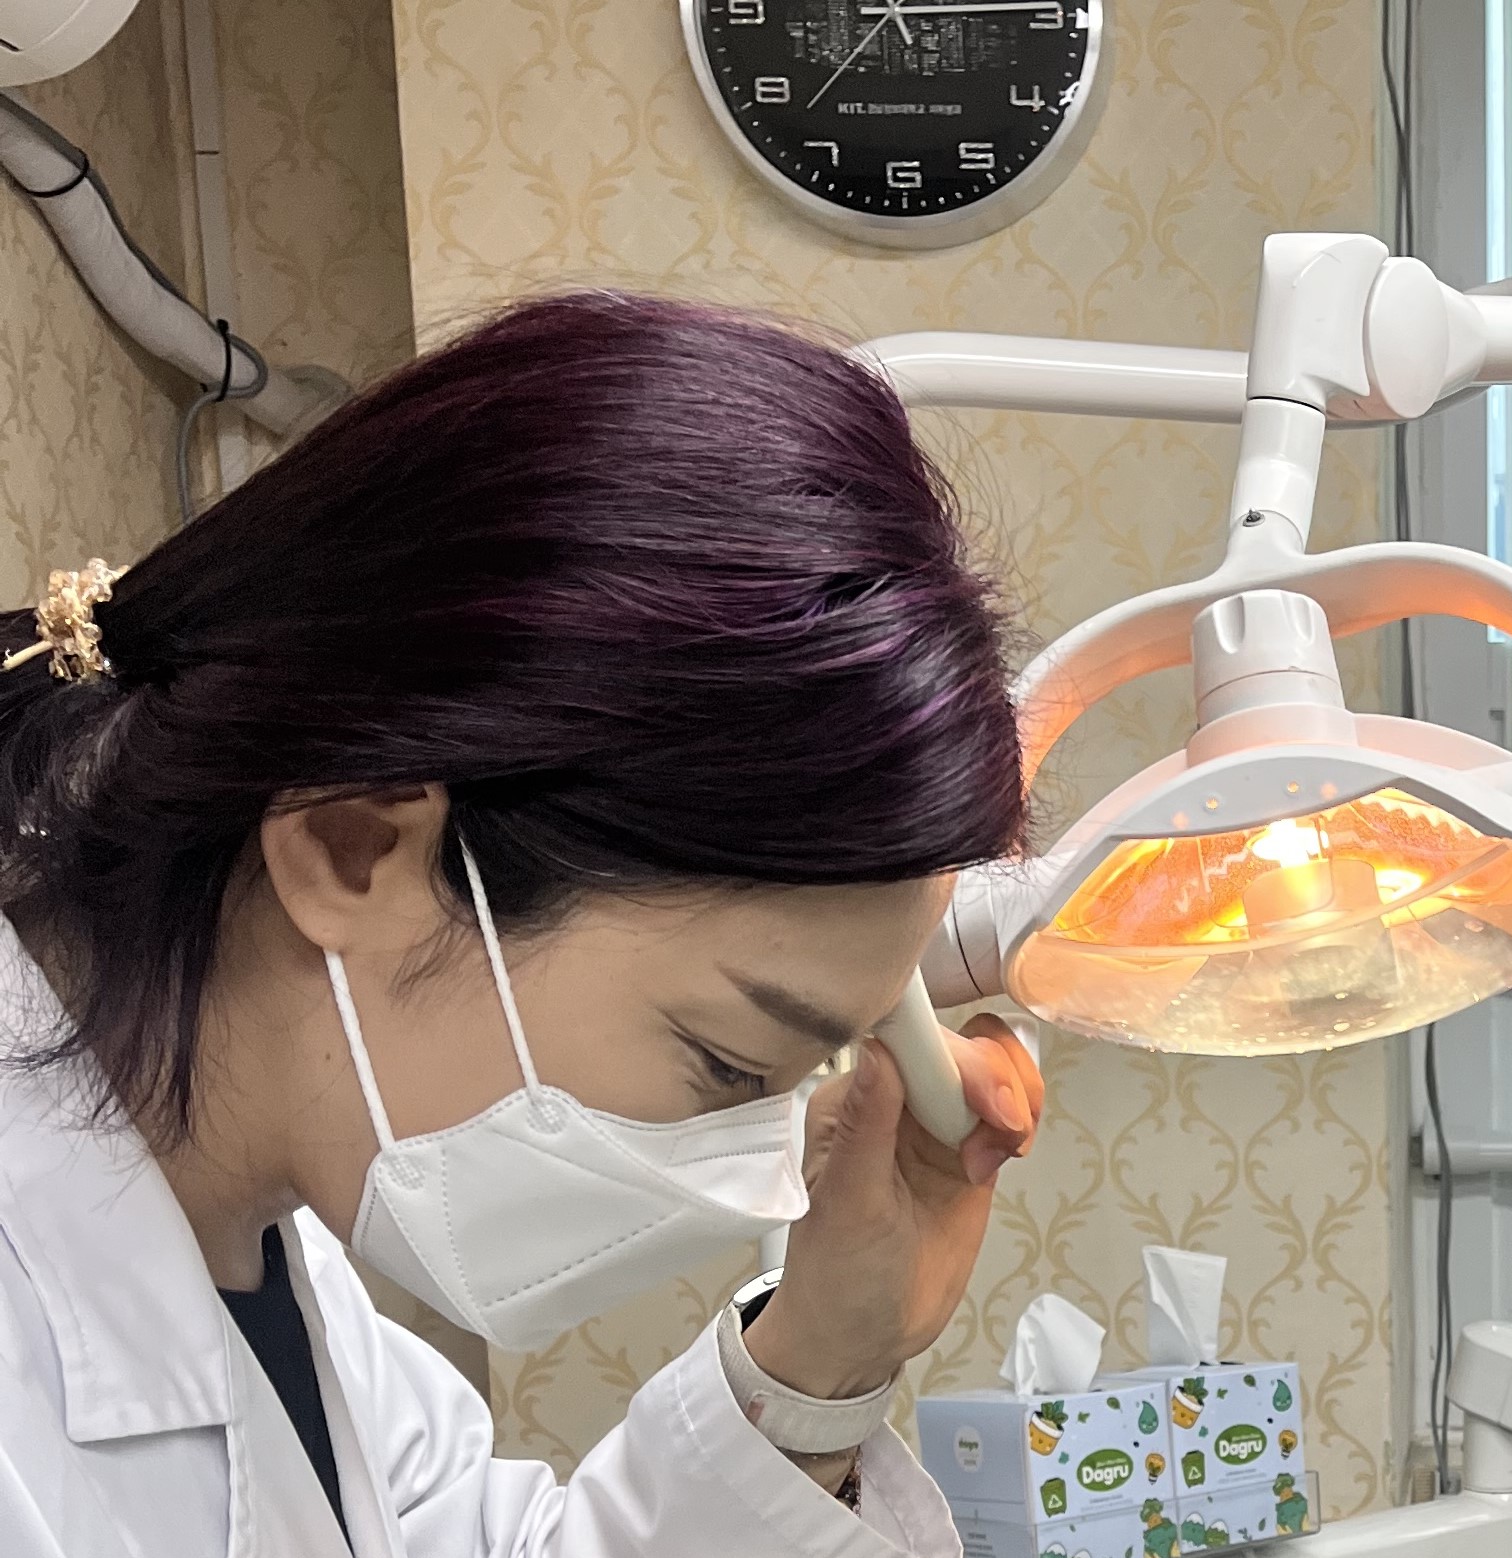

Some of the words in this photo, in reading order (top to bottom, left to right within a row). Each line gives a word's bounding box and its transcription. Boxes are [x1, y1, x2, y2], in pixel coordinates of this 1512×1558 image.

[754, 76, 790, 103] 8
[1009, 84, 1046, 109] 4
[803, 140, 838, 167] 7
[958, 142, 995, 169] 5
[886, 160, 922, 188] 6
